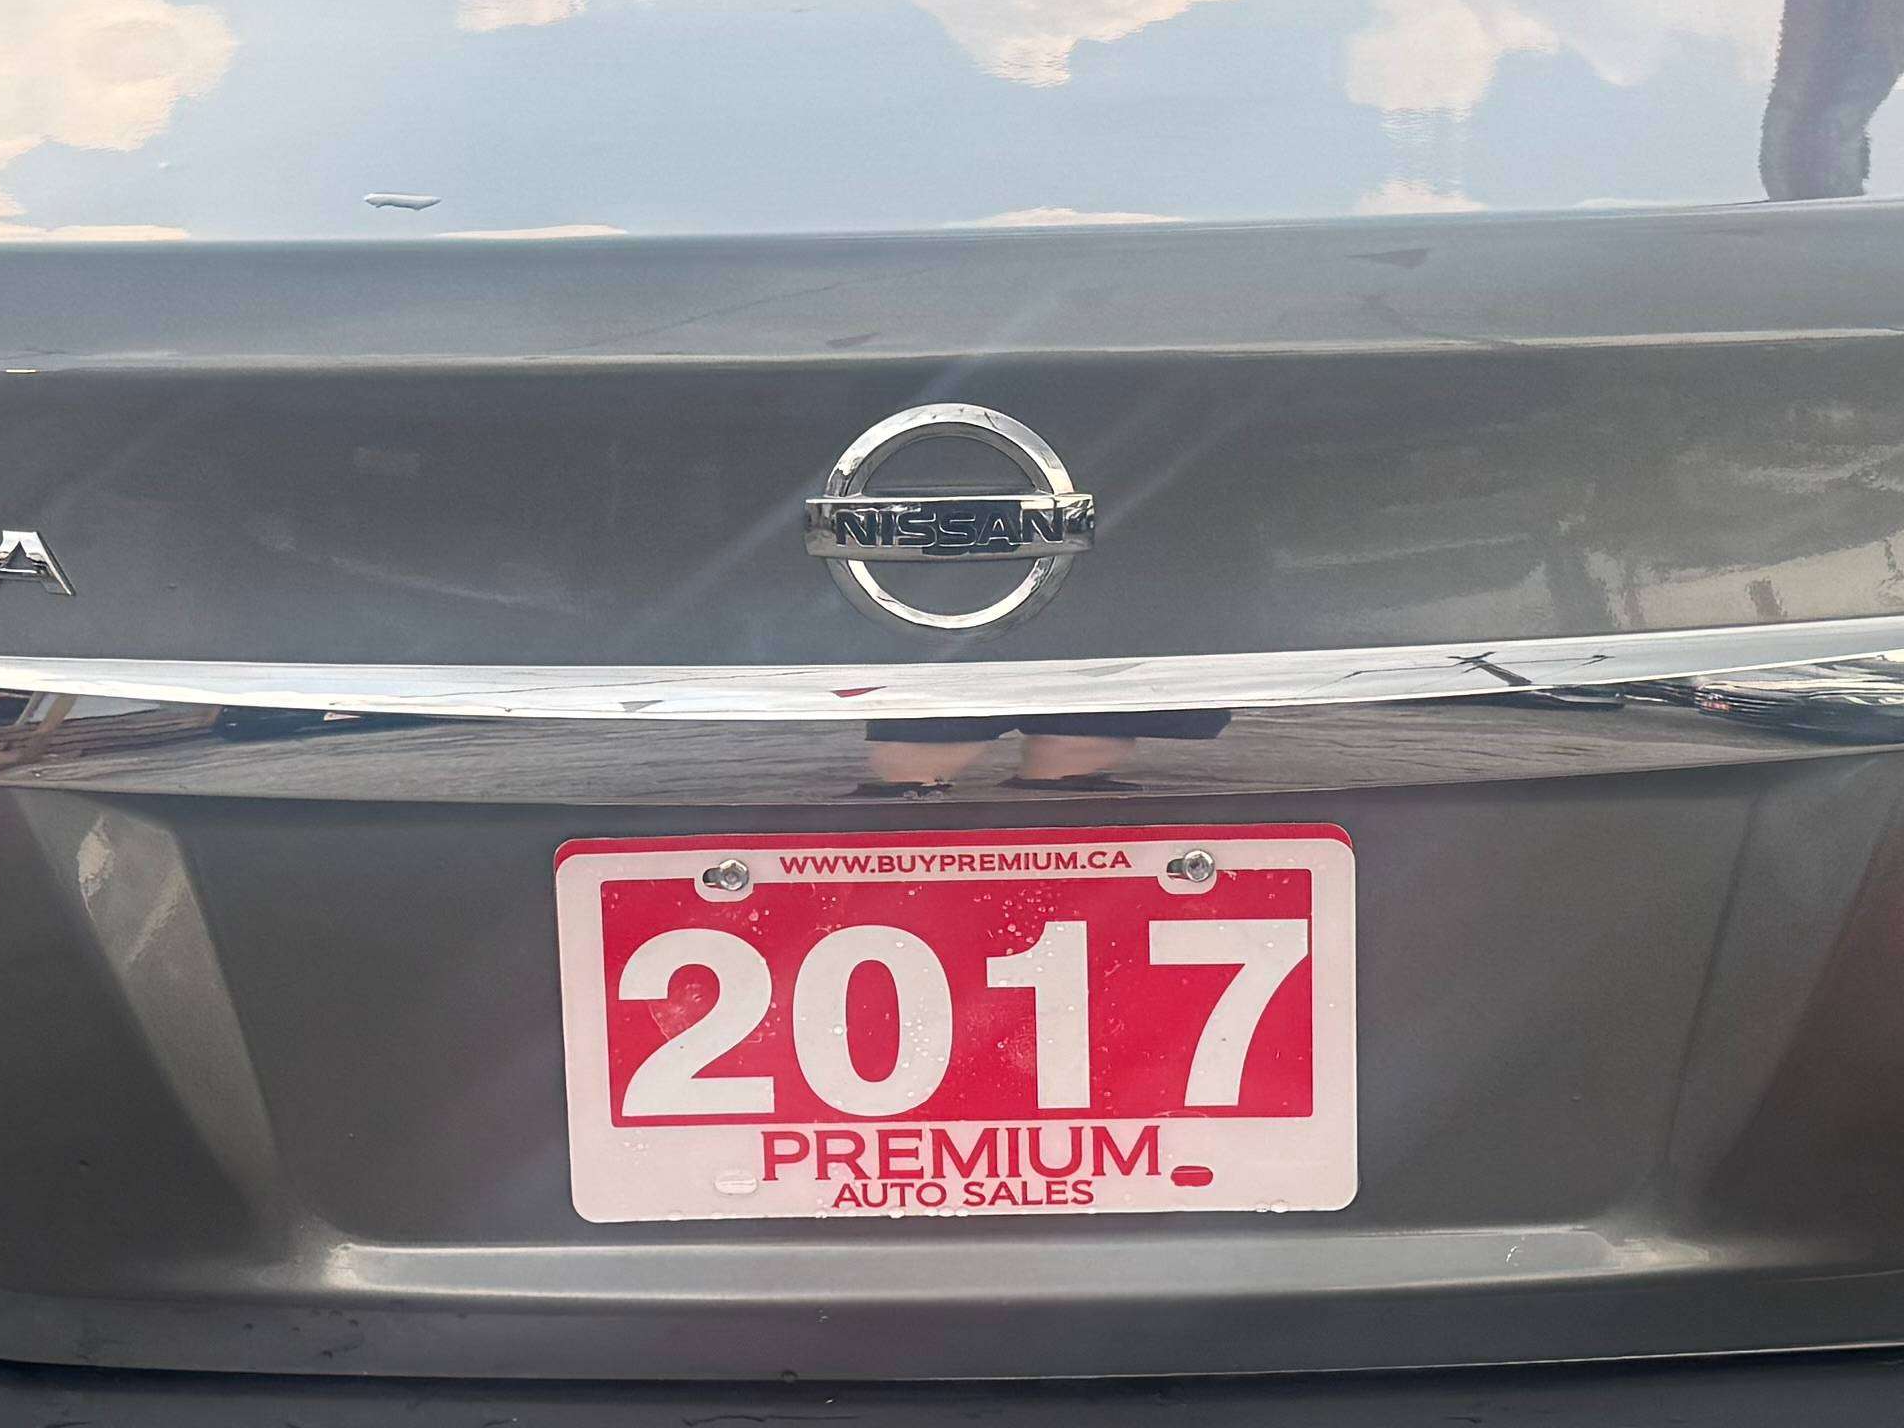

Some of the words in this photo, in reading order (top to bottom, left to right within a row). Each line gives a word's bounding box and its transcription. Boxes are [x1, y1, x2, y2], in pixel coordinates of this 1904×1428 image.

[835, 507, 1064, 548] NISSAN
[780, 850, 1133, 875] WWW.BUYPREMIUM.CA
[617, 919, 1309, 1117] 2017
[761, 1125, 1161, 1182] PREMIUM
[831, 1182, 947, 1209] AUTO
[962, 1179, 1095, 1207] SALES
